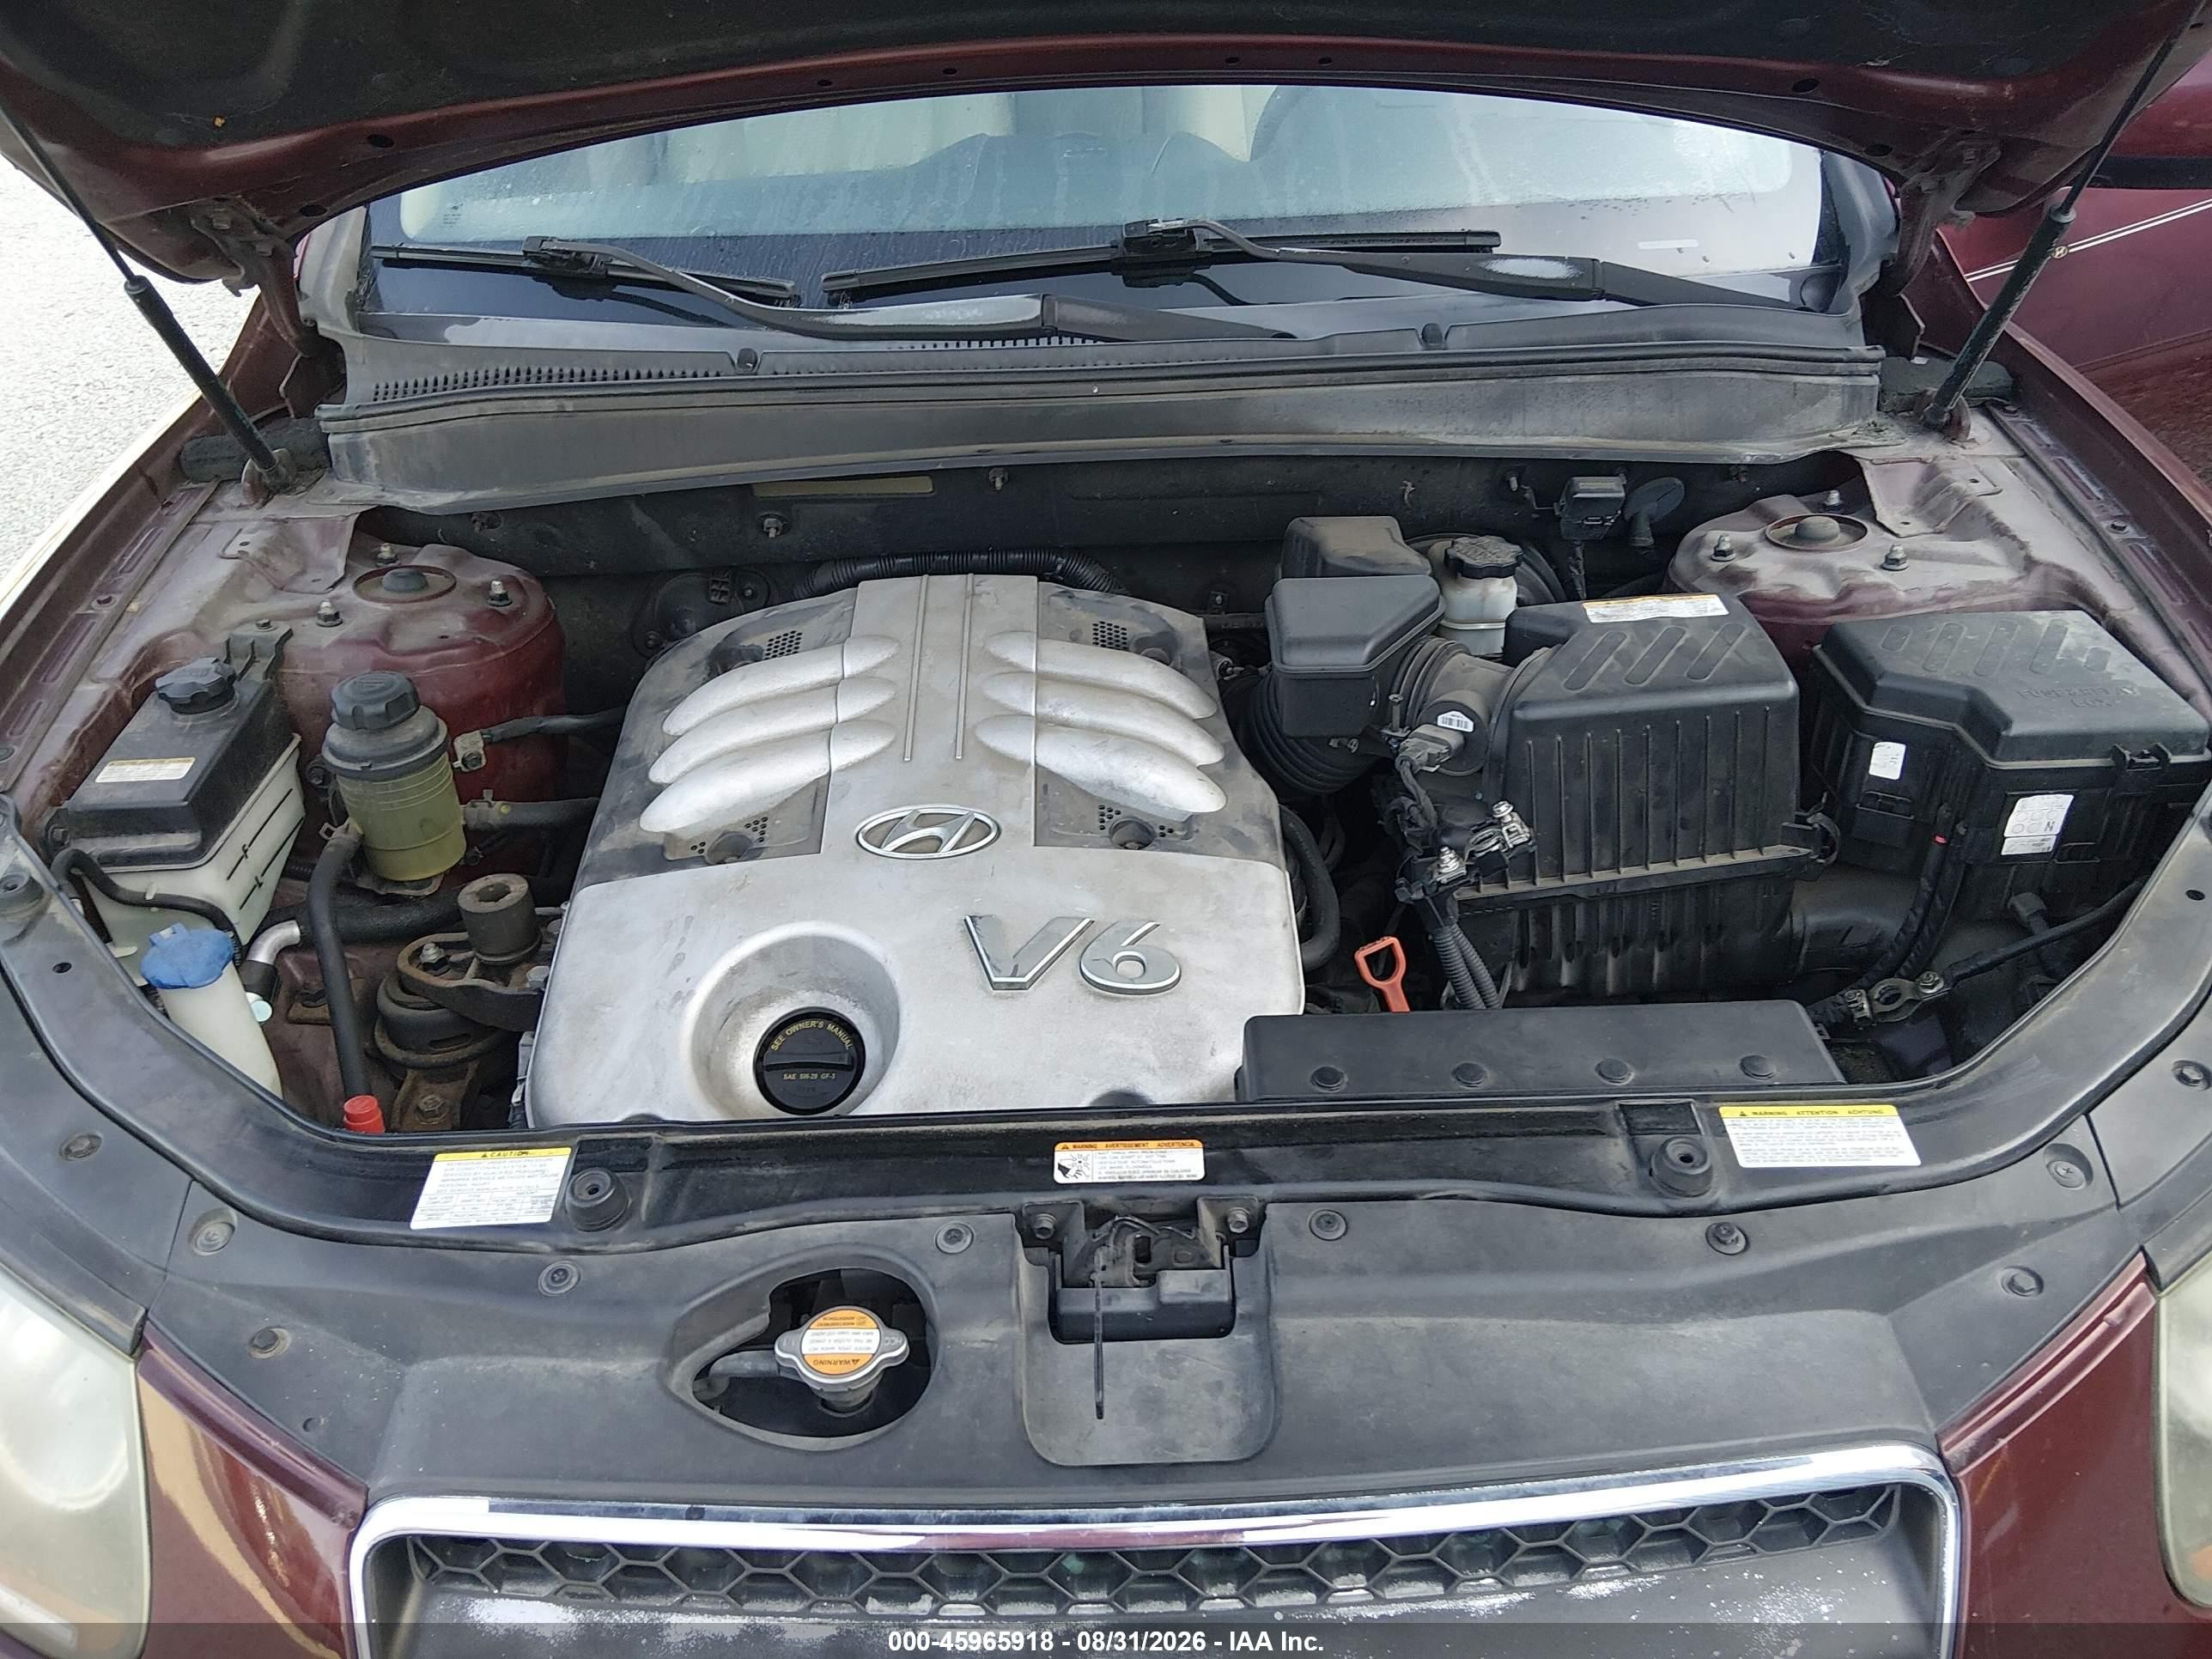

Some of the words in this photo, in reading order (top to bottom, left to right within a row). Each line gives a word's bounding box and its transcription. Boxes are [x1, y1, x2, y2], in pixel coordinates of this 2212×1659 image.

[963, 914, 1182, 995] V6
[771, 1035, 786, 1051] SEE
[785, 1020, 824, 1036] OWNER'S
[826, 1023, 853, 1050] MANUAL
